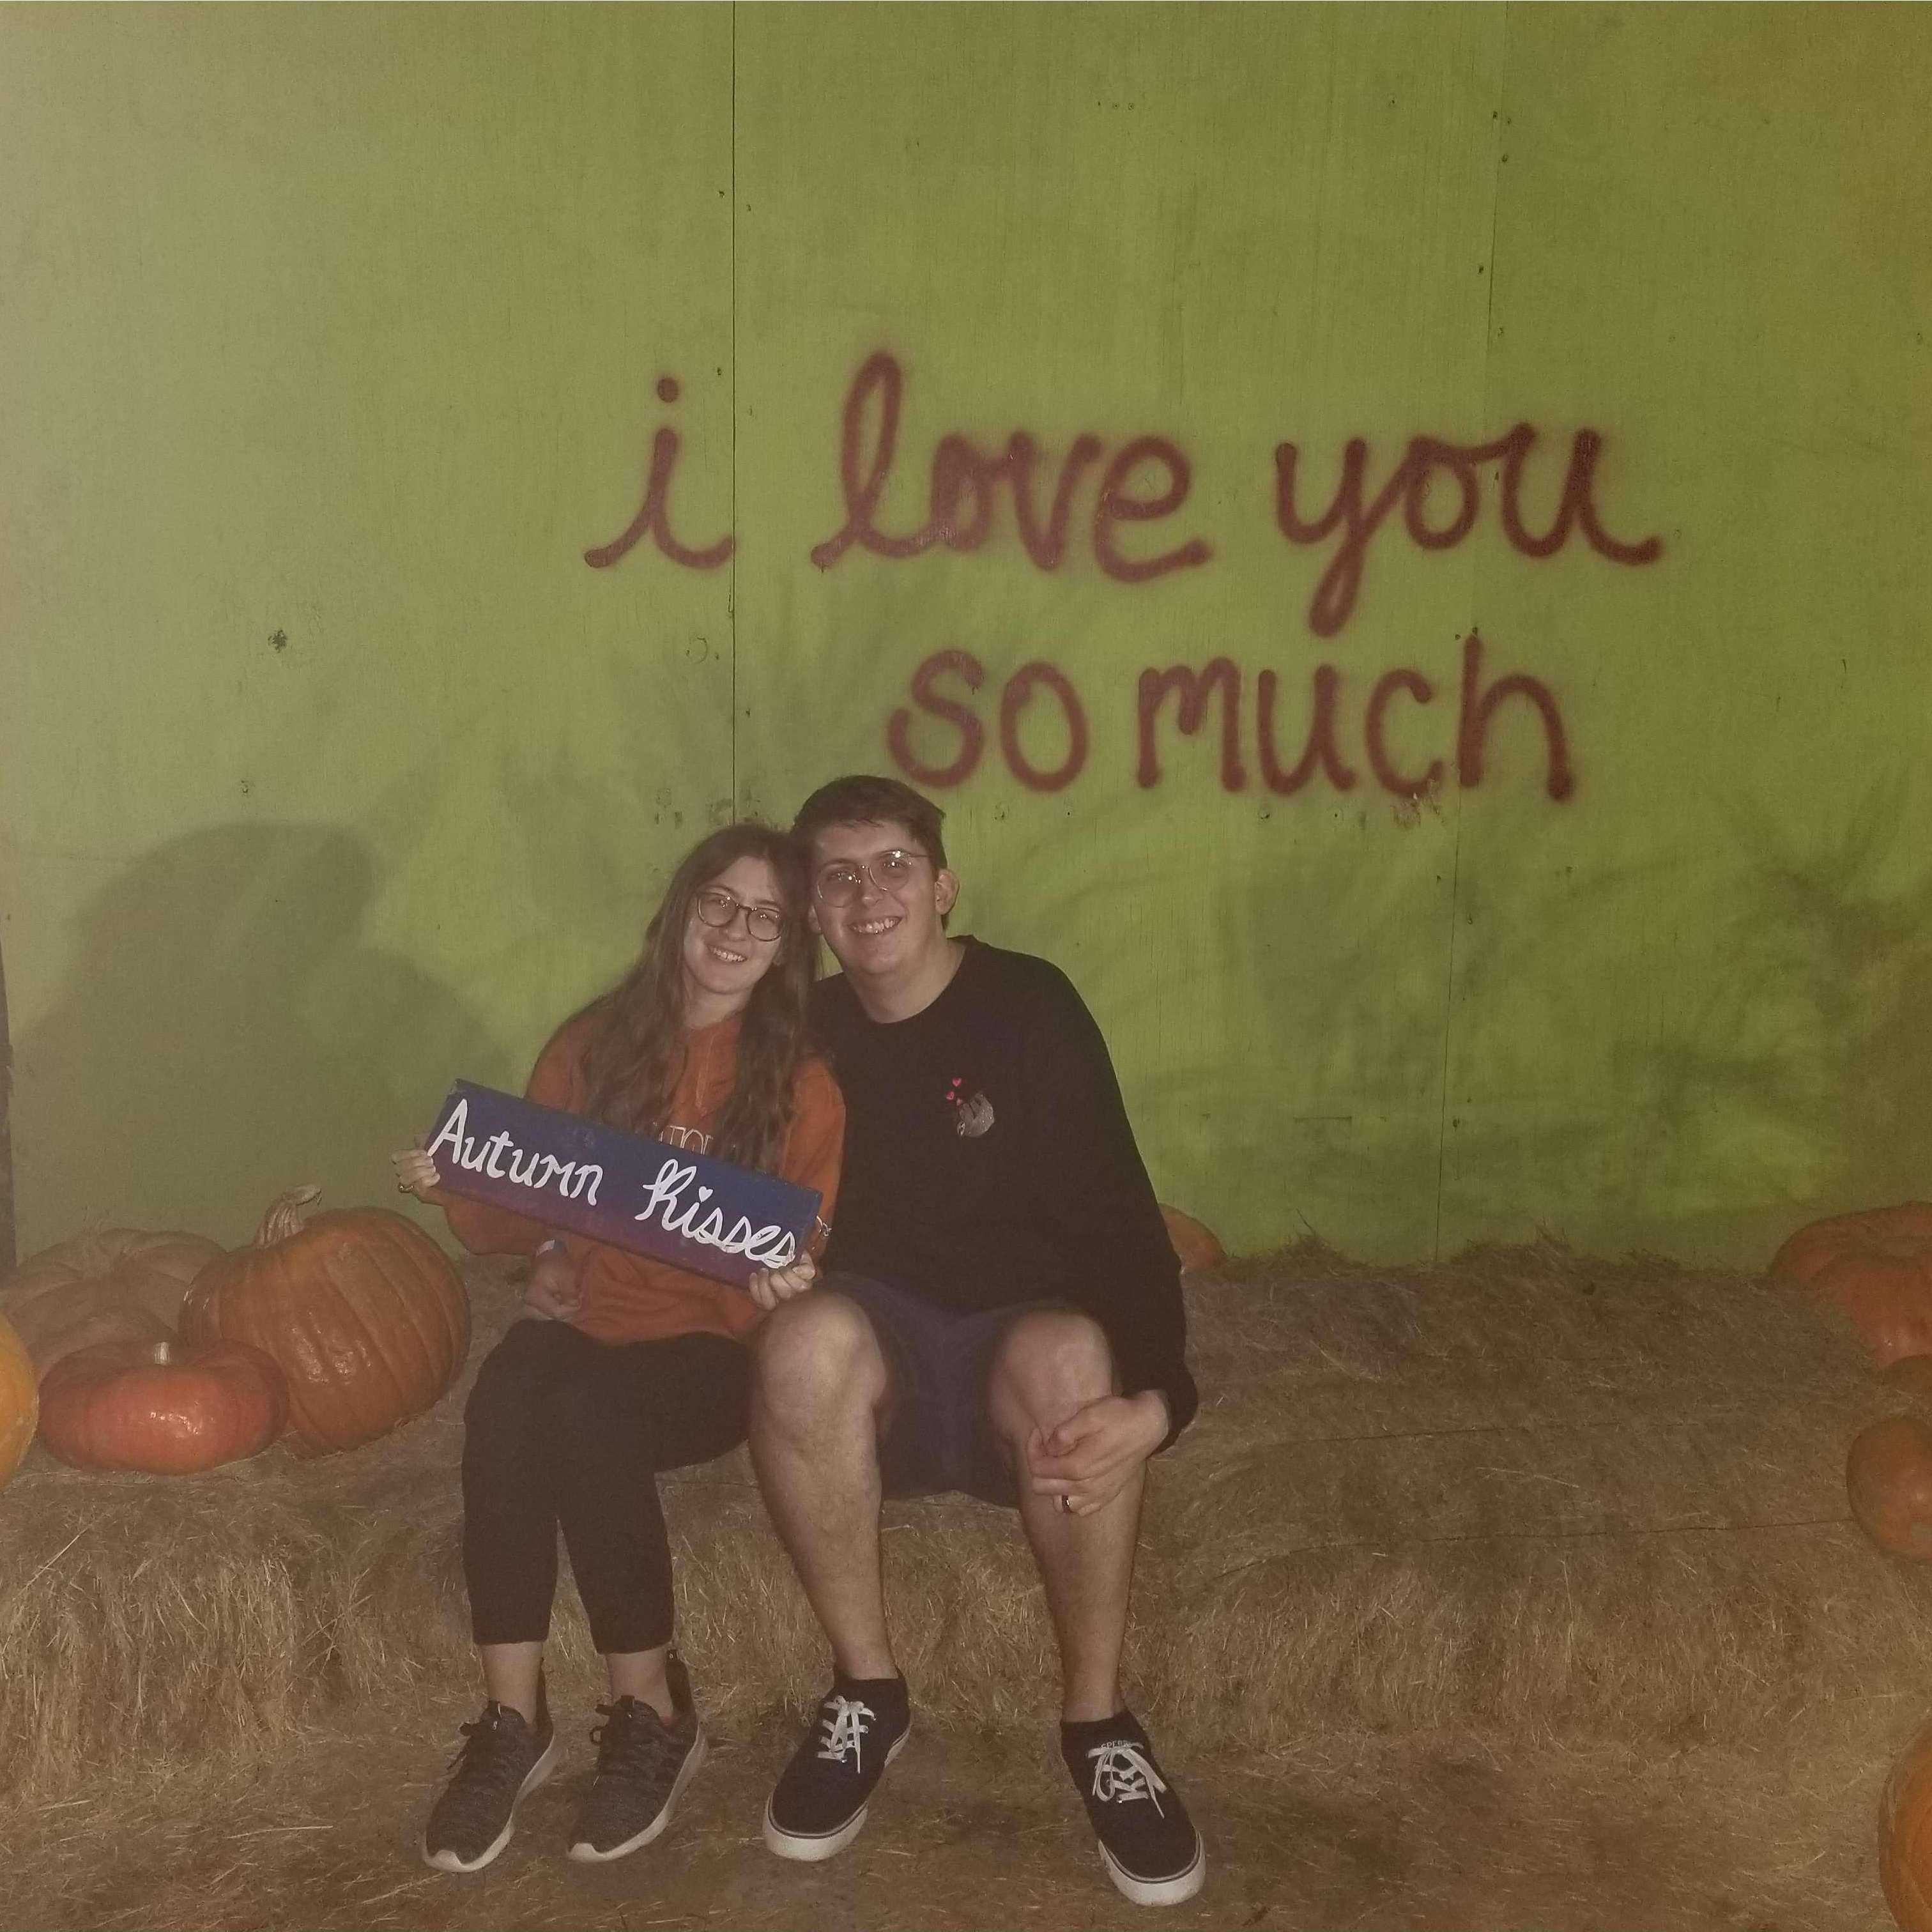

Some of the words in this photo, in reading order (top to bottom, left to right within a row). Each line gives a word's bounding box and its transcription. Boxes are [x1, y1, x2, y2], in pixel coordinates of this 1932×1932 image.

[584, 376, 735, 570] i
[811, 350, 1211, 583] love
[1275, 422, 1662, 638] you
[887, 650, 1090, 792] so
[1135, 635, 1576, 803] much
[427, 1098, 603, 1206] Autumn
